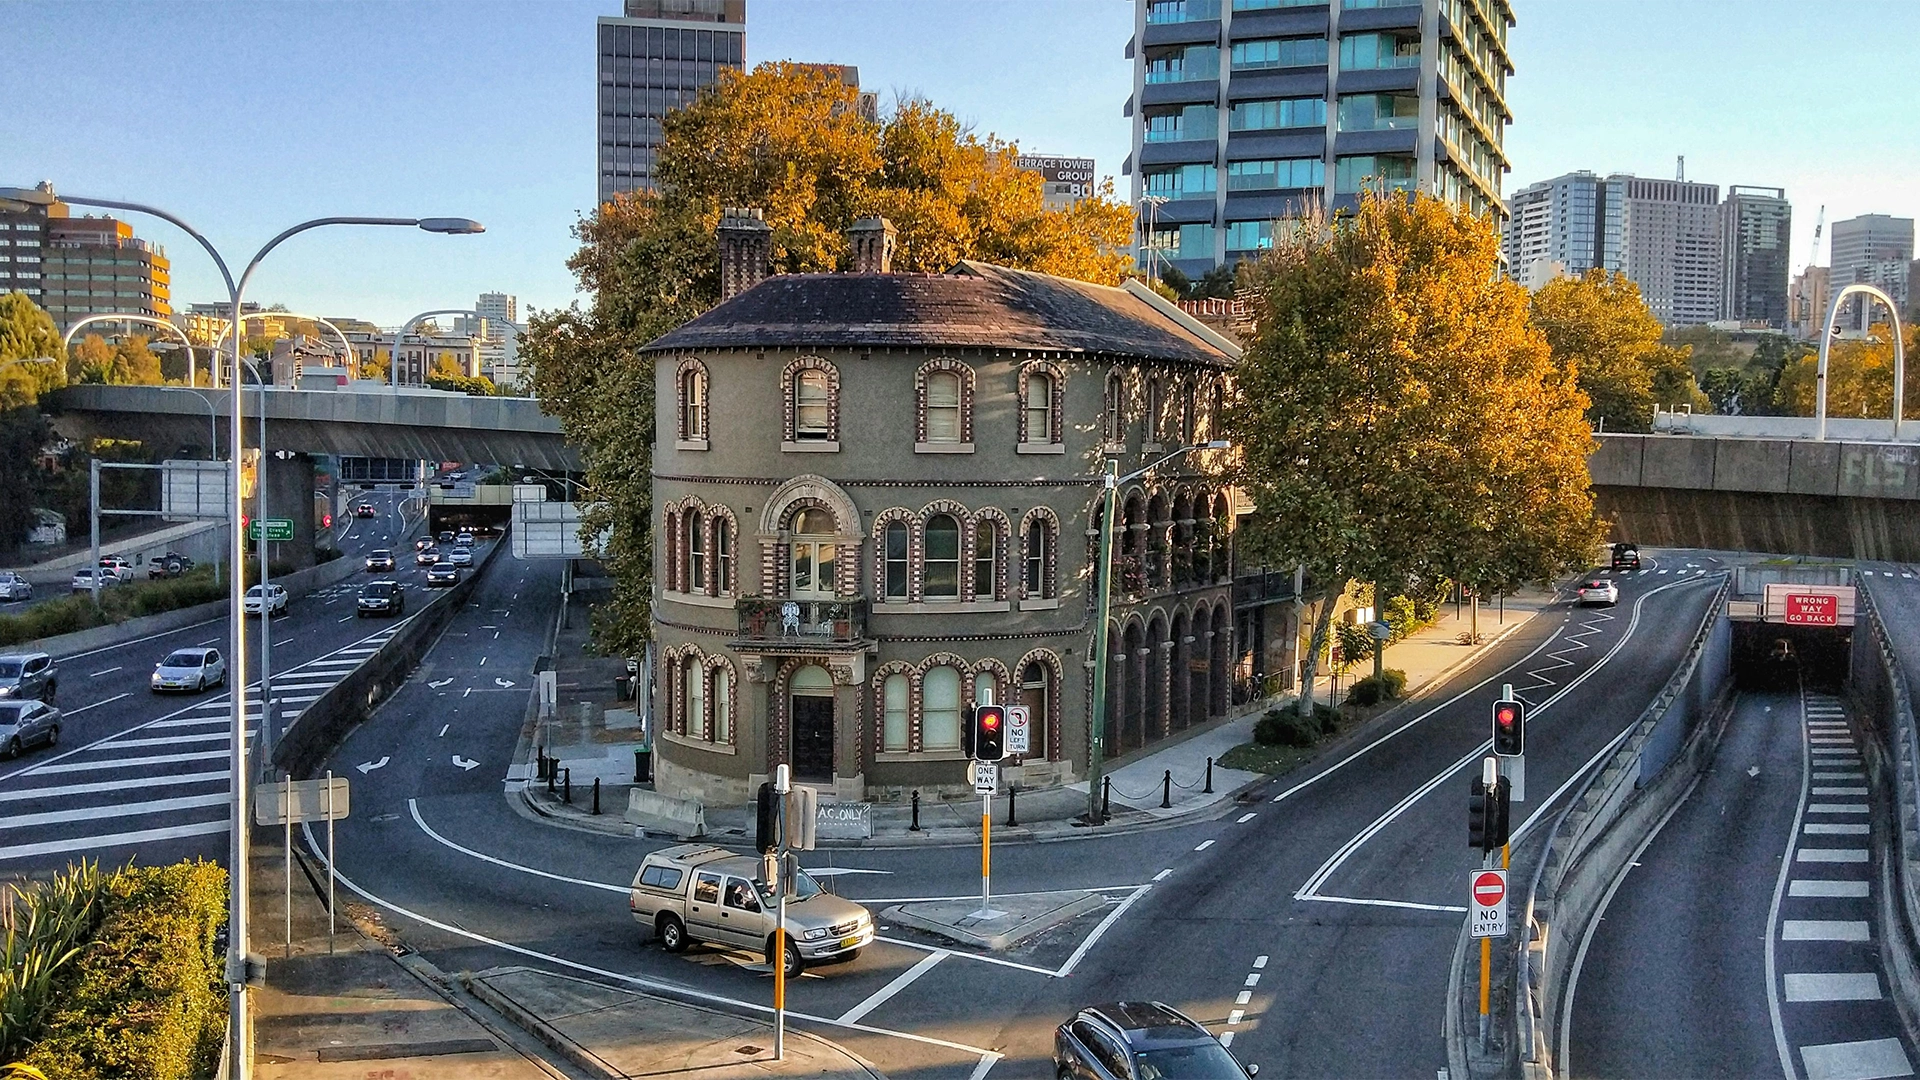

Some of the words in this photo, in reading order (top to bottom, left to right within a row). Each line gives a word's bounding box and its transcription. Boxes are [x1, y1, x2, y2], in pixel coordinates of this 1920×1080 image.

[1013, 158, 1055, 169] TERRACE
[1058, 160, 1093, 170] TOWER
[1057, 171, 1093, 181] GROUP
[1795, 597, 1829, 605] WRONG
[1011, 728, 1024, 737] NO
[977, 767, 994, 775] ONE
[977, 776, 995, 784] WAY
[1480, 909, 1498, 920] NO
[1473, 922, 1504, 932] ENTRY
